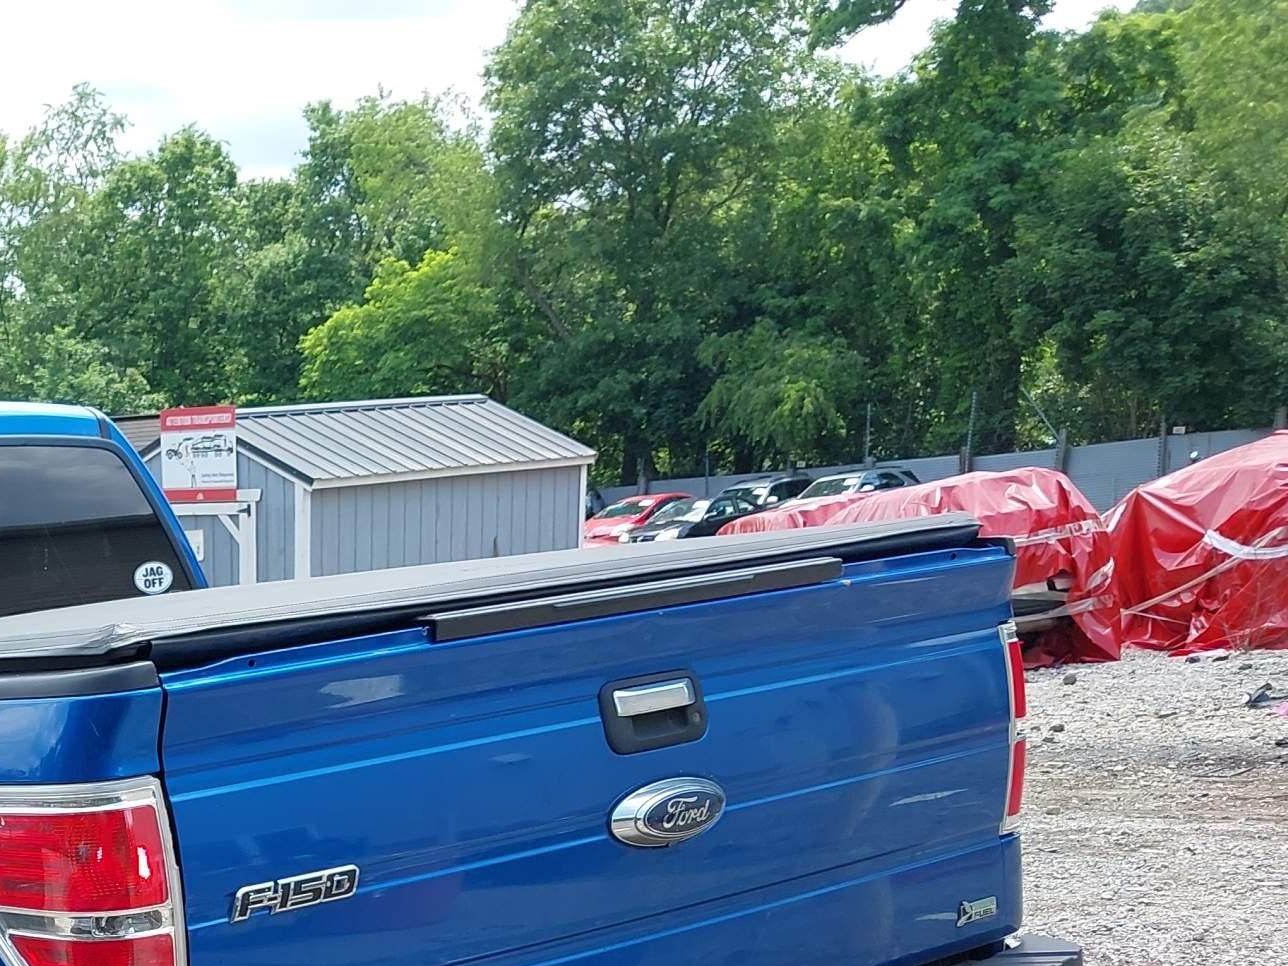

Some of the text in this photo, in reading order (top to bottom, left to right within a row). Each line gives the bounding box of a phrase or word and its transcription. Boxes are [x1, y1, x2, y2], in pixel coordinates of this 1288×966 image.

[142, 566, 164, 577] JAG
[144, 577, 164, 589] OFF
[663, 796, 710, 829] Ford
[231, 864, 359, 923] F-150
